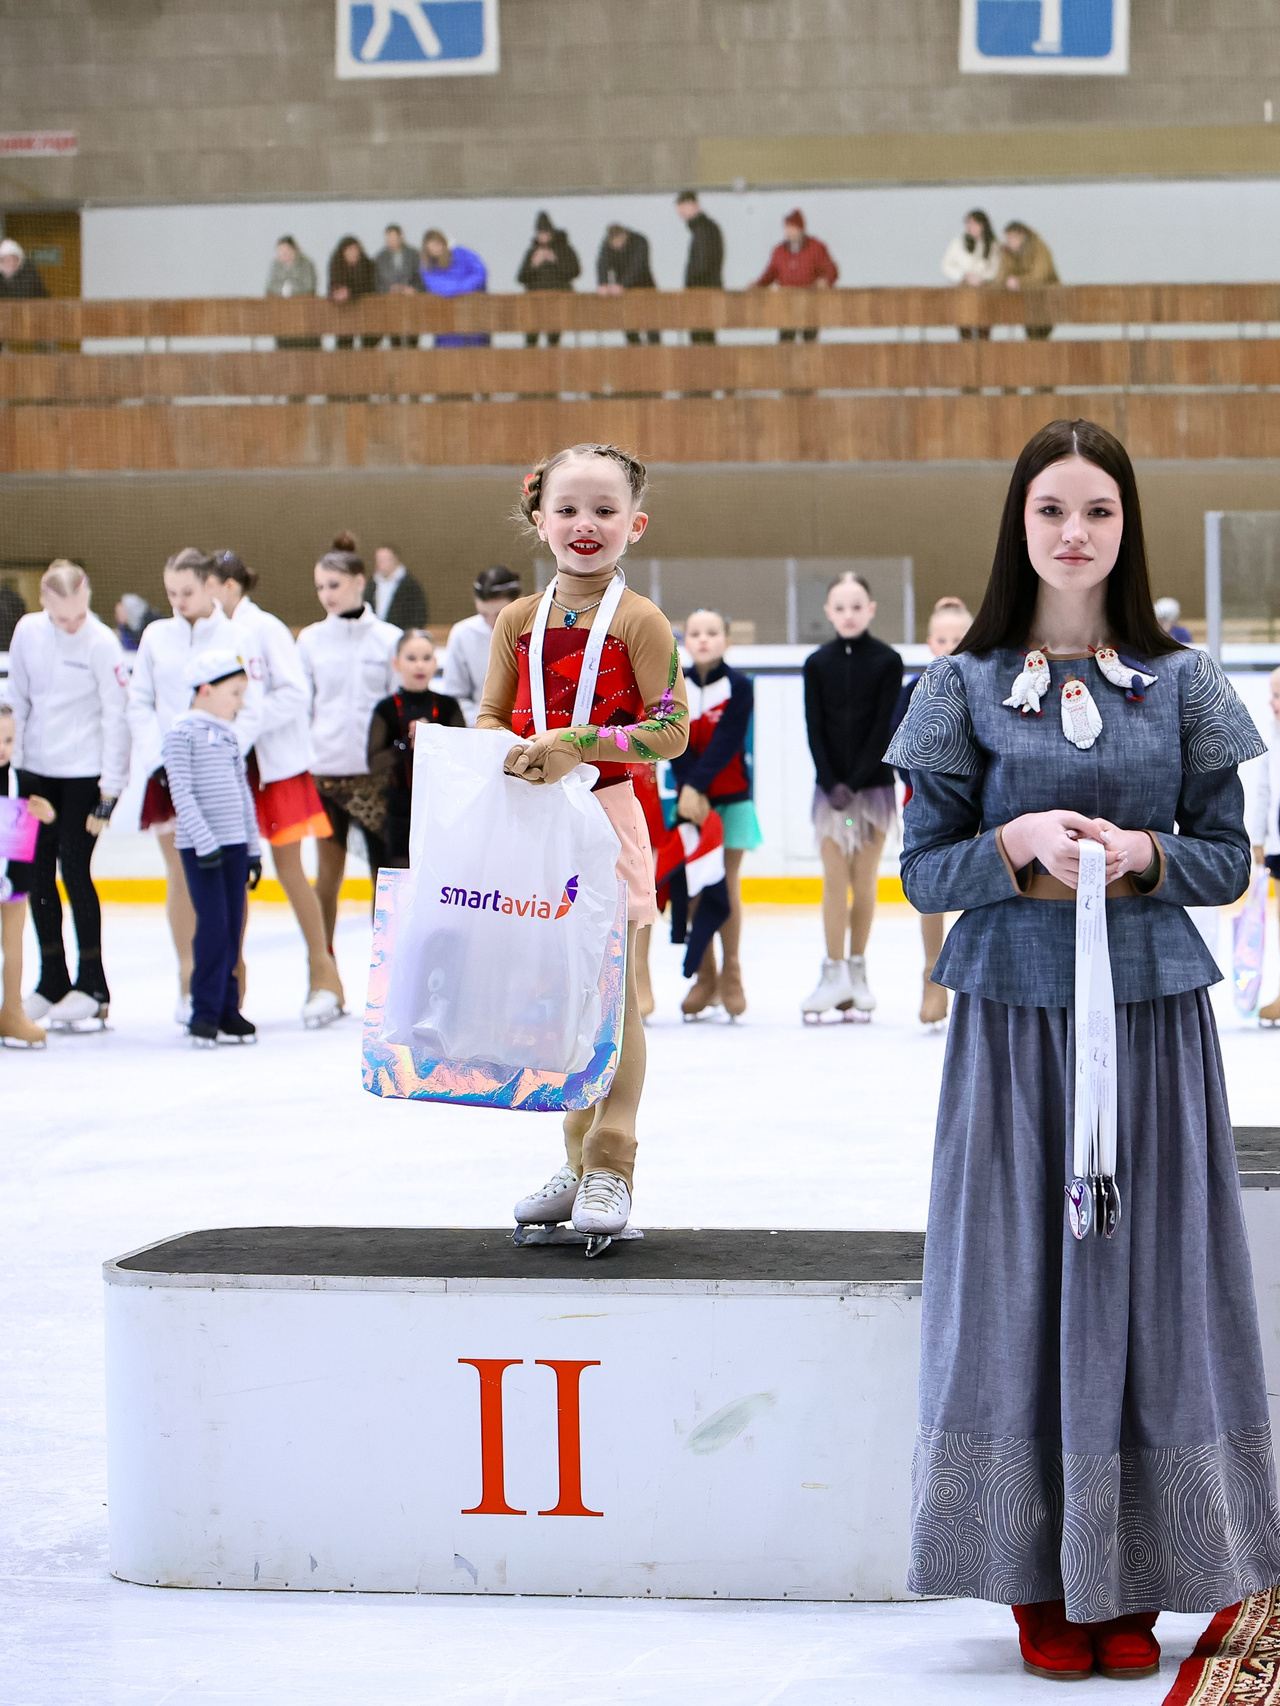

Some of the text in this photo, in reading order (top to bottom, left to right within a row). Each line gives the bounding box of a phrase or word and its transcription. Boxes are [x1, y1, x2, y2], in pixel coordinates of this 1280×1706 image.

[1081, 858, 1089, 886] CANDY
[1088, 858, 1096, 886] КУБОК
[439, 885, 551, 919] smartavia
[457, 1358, 604, 1517] II
